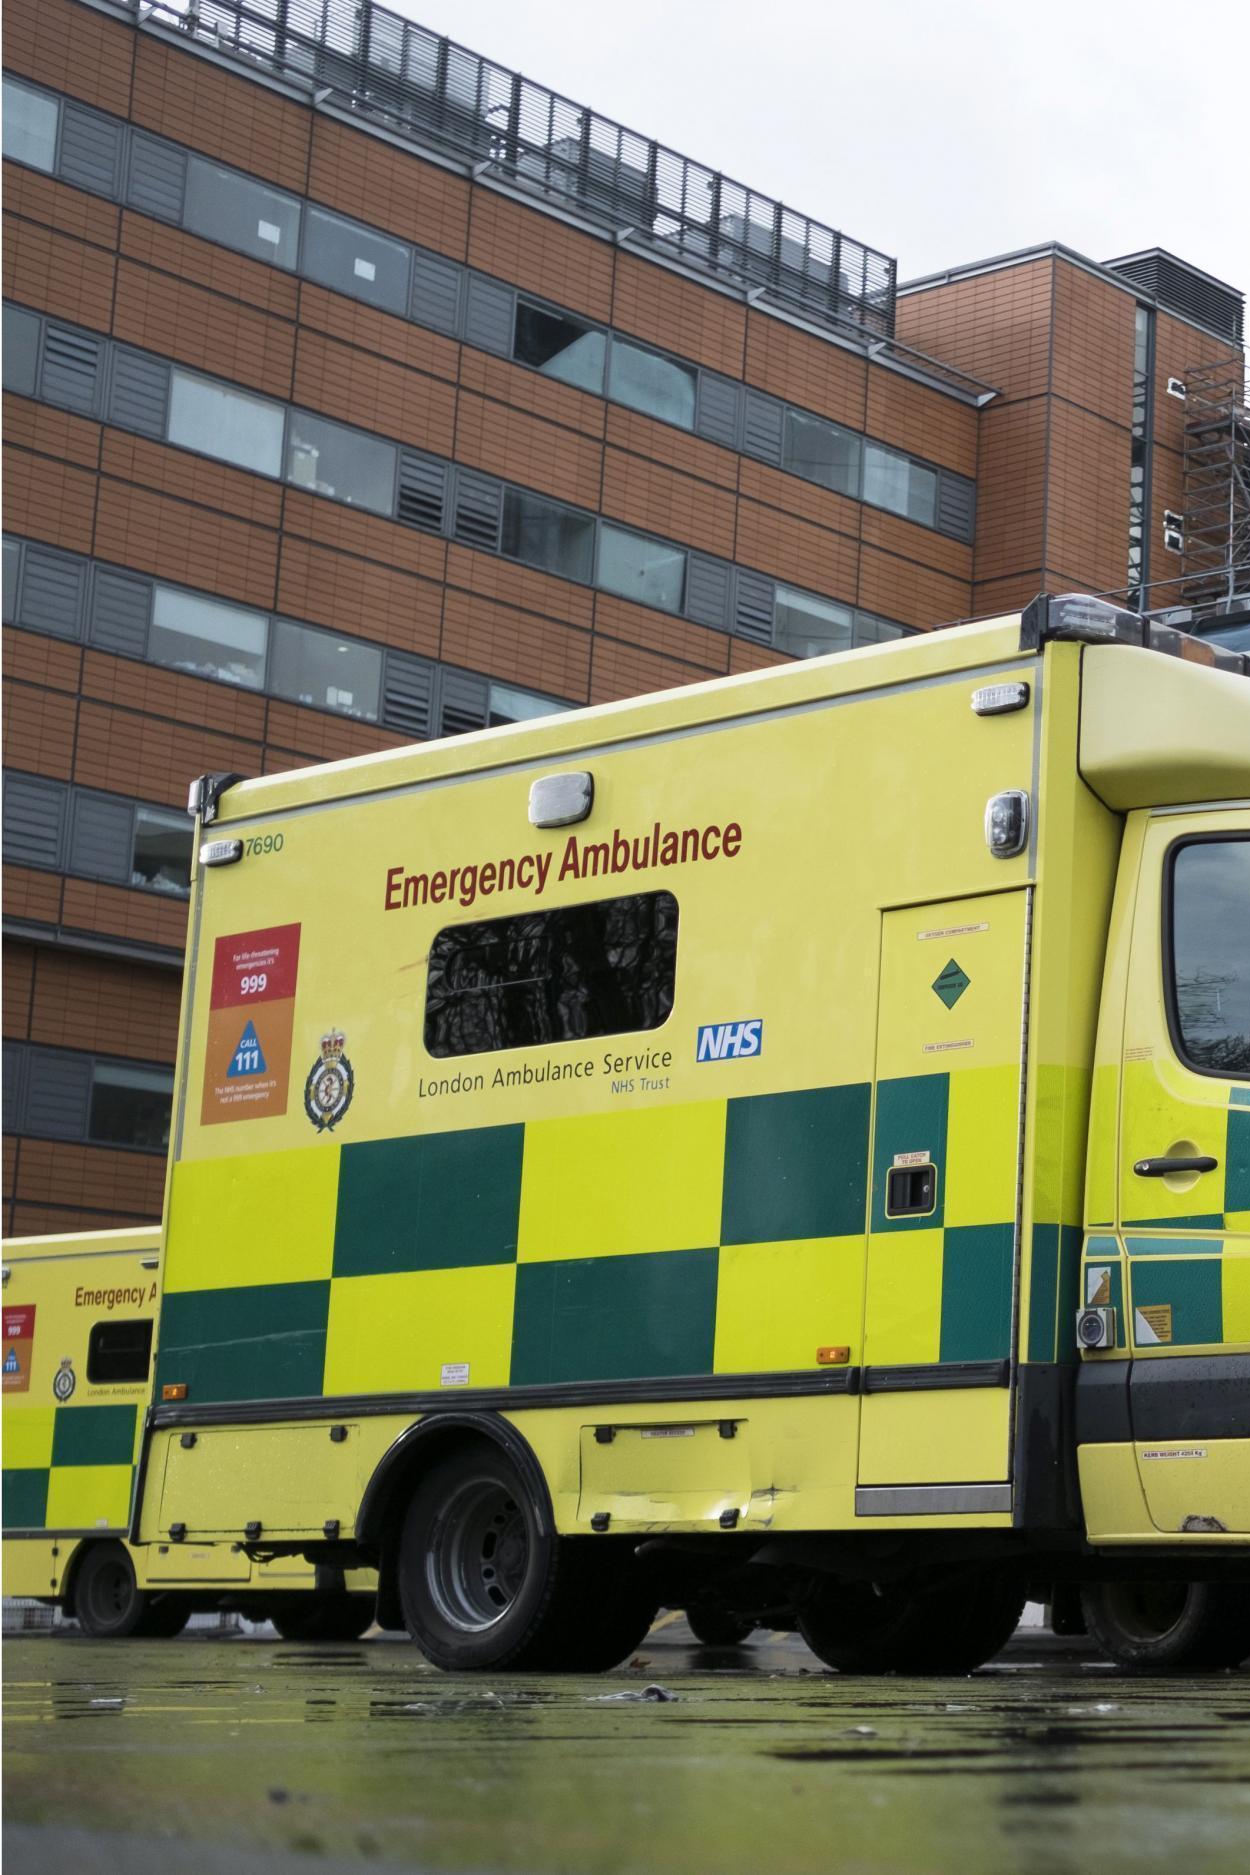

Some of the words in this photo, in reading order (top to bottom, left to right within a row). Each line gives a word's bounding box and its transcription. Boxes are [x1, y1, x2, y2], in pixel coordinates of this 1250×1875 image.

[246, 833, 284, 856] 7690
[385, 852, 552, 911] Emergency
[558, 822, 742, 881] Ambulance
[240, 973, 267, 995] 999
[240, 1039, 257, 1049] CALL
[697, 1021, 762, 1061] NHS
[236, 1050, 259, 1071] 111
[419, 1072, 484, 1098] London
[492, 1060, 594, 1088] Ambulance
[603, 1048, 672, 1075] Service
[611, 1079, 635, 1094] NHS
[640, 1077, 670, 1090] Trust
[75, 1286, 145, 1310] Emergency
[88, 1388, 110, 1397] London
[112, 1387, 145, 1395] Ambulance
